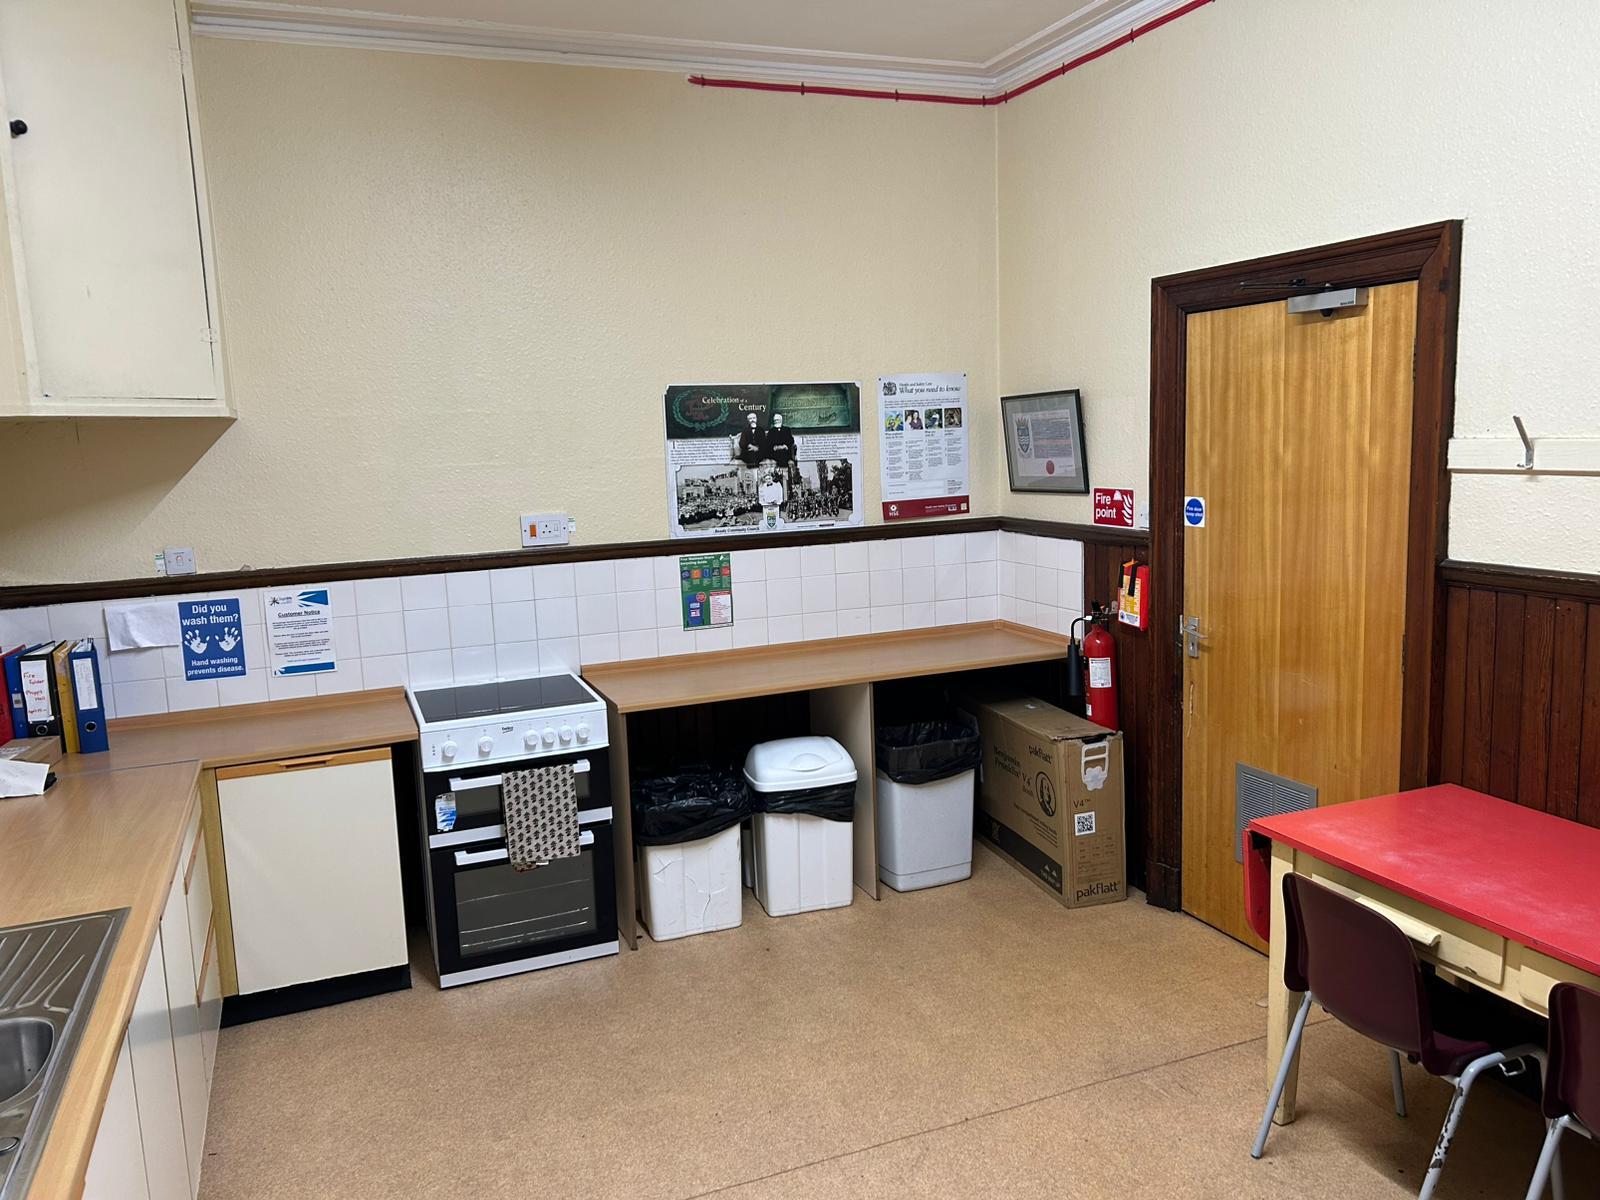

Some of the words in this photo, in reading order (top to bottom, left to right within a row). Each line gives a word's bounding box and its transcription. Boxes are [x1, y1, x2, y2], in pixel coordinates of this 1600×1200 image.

[702, 396, 739, 404] Celebration
[738, 403, 766, 412] Century
[1095, 492, 1111, 505] Fire
[1095, 506, 1116, 520] point
[192, 604, 208, 614] Did
[209, 604, 227, 614] you
[182, 615, 207, 626] wash
[209, 613, 239, 625] them?
[210, 657, 238, 665] washing
[187, 667, 216, 676] prevents
[217, 665, 244, 673] disease.
[1076, 881, 1119, 902] pakflatt
